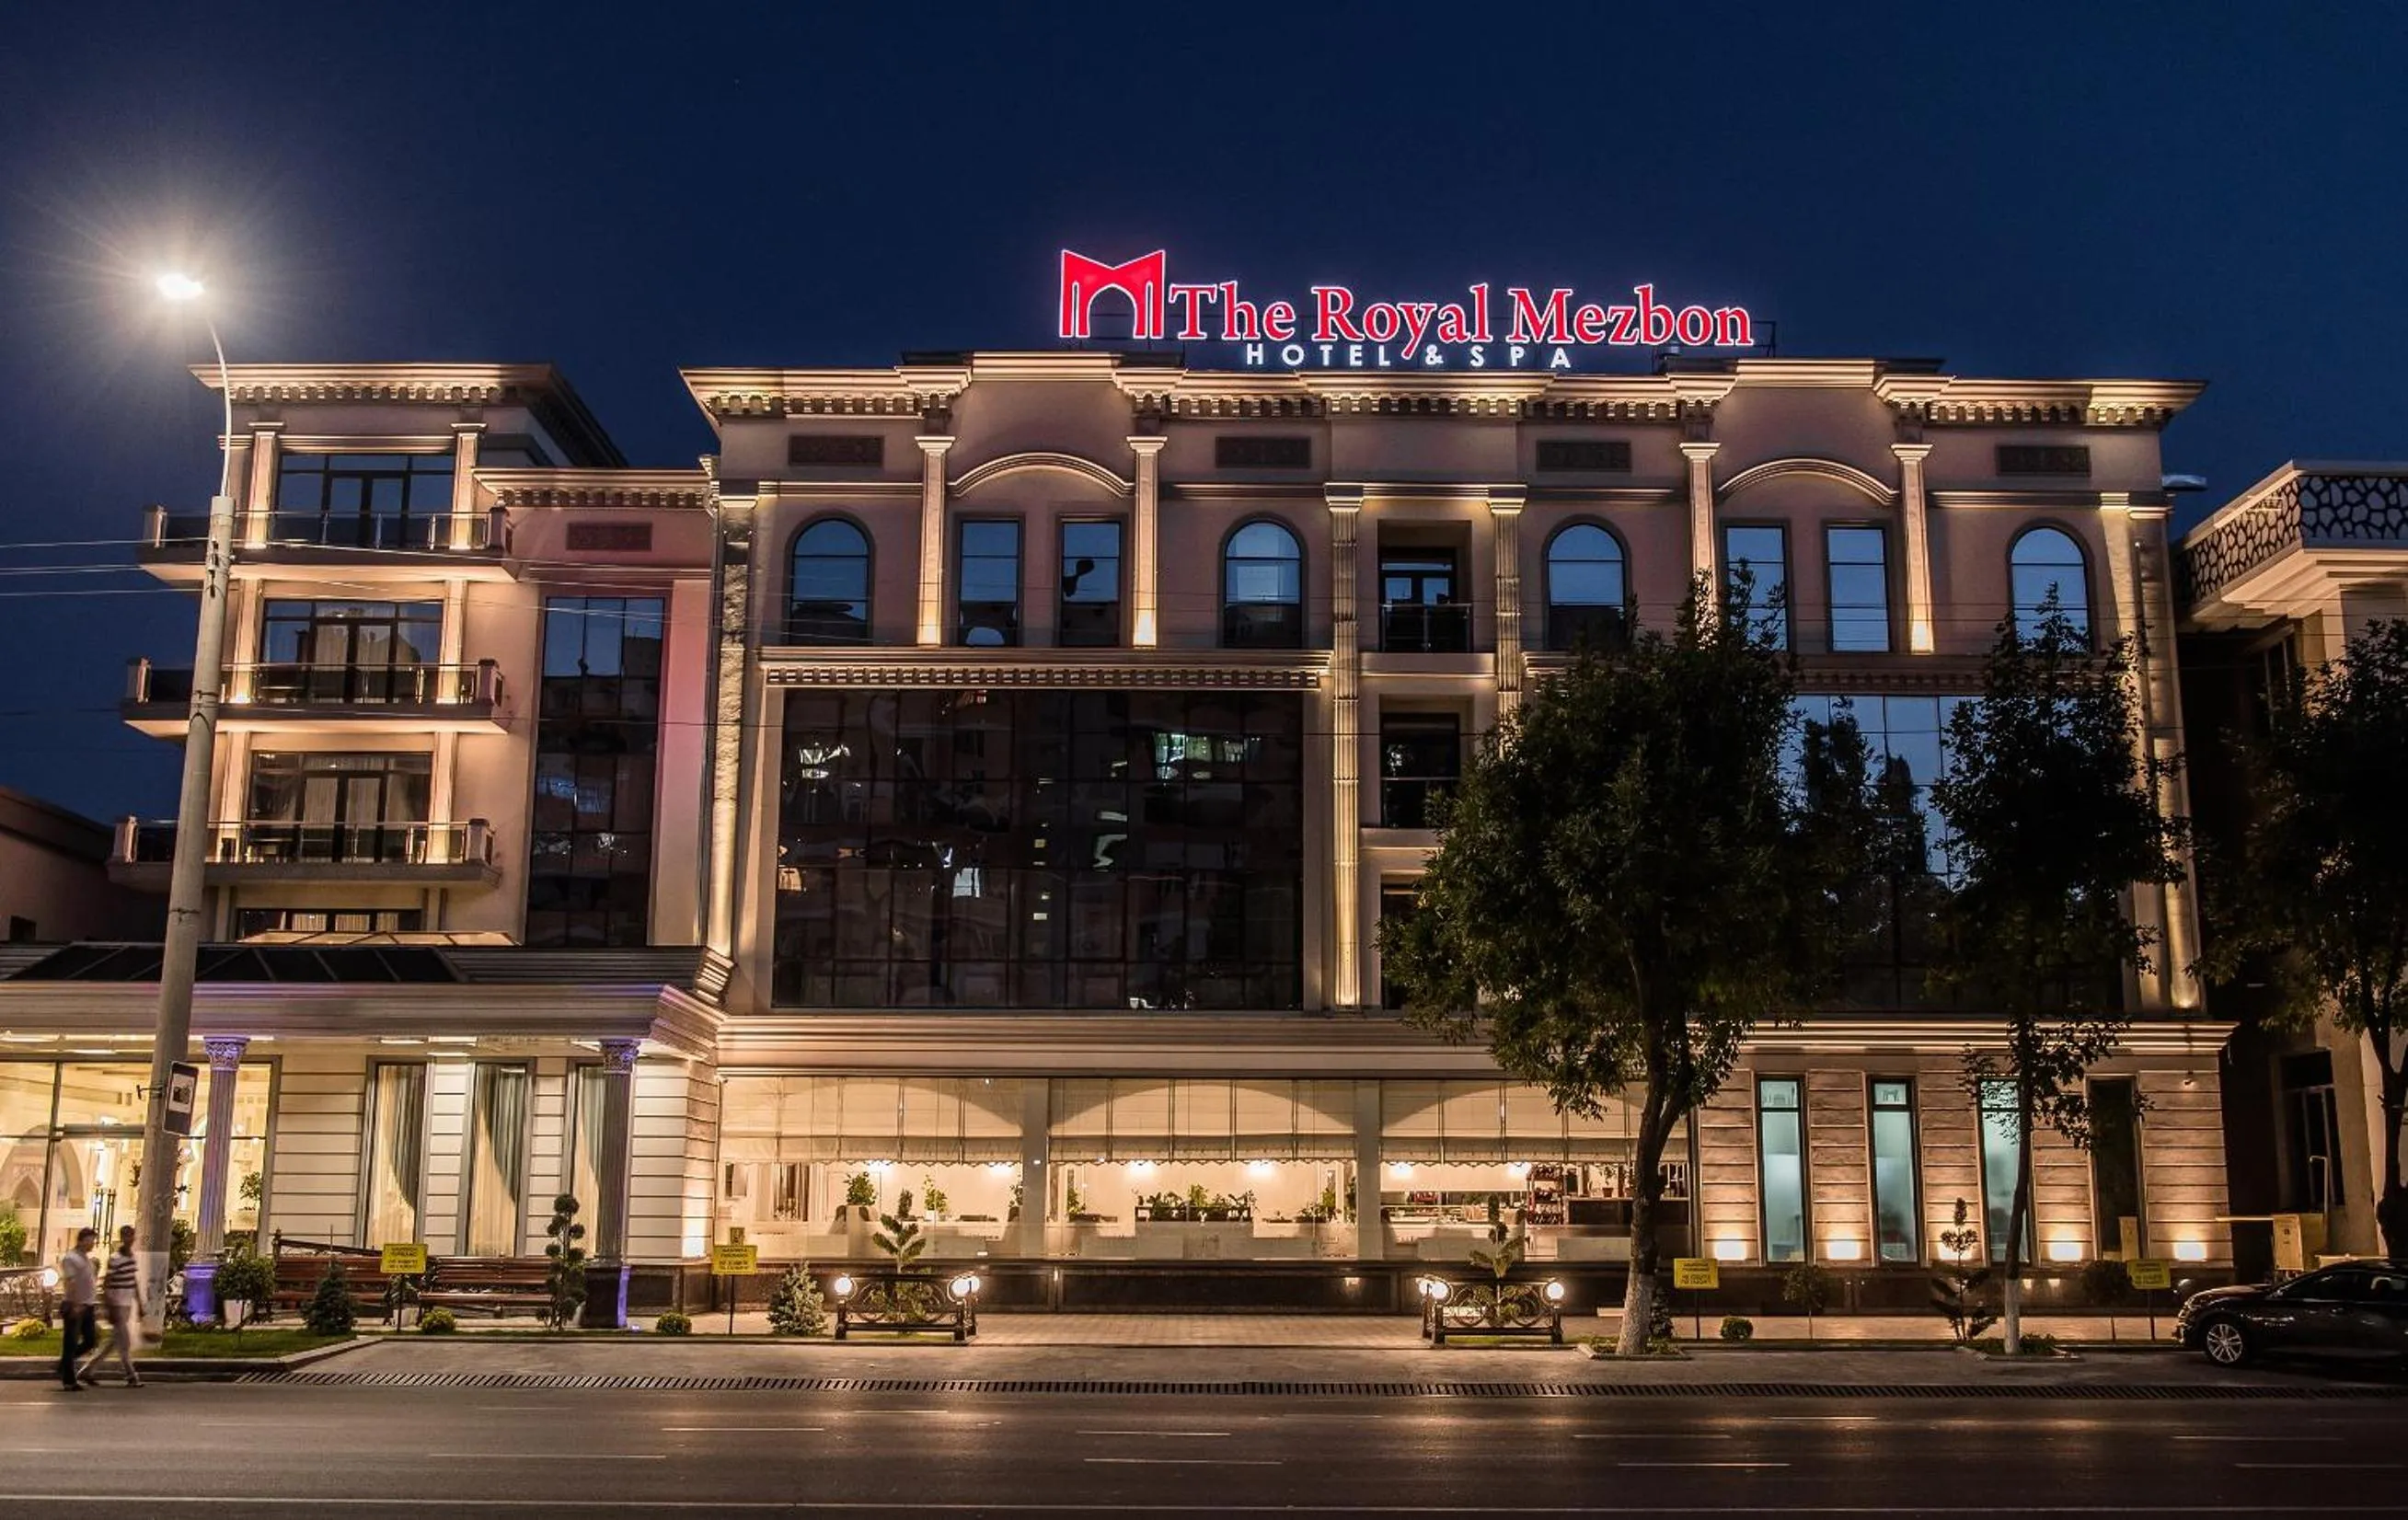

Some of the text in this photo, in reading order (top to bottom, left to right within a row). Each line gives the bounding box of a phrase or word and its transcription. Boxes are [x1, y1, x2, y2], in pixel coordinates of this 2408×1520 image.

[1168, 280, 1754, 360] The Royal Mezbon
[1246, 343, 1572, 369] HOTEL & SPA
